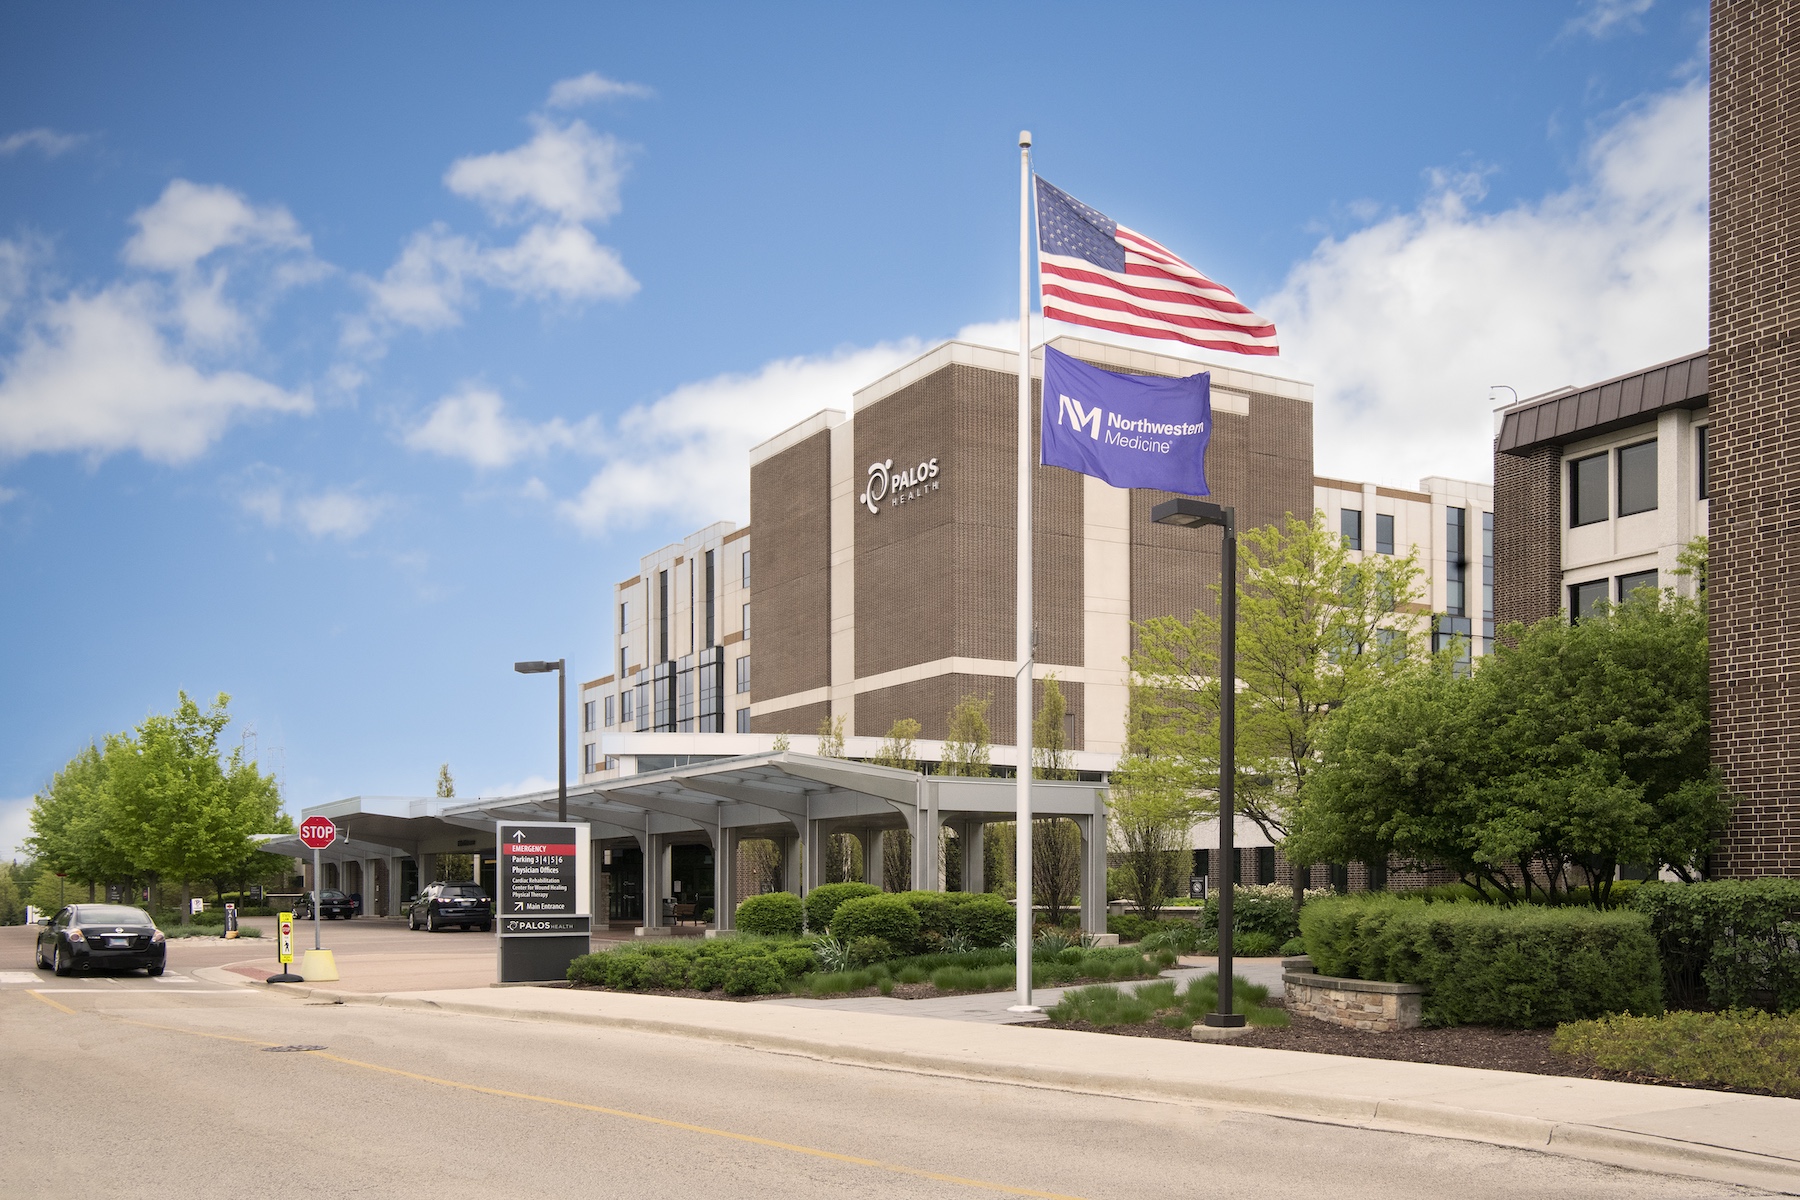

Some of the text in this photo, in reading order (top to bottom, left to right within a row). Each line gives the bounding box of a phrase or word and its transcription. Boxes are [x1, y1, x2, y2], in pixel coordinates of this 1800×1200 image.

[1107, 412, 1204, 436] Northwestern
[891, 458, 940, 494] PALOS
[891, 481, 940, 507] HEALTH
[302, 825, 333, 839] STOP
[512, 855, 534, 864] Parking
[512, 866, 559, 875] Physician Offices
[520, 922, 550, 930] PALOS
